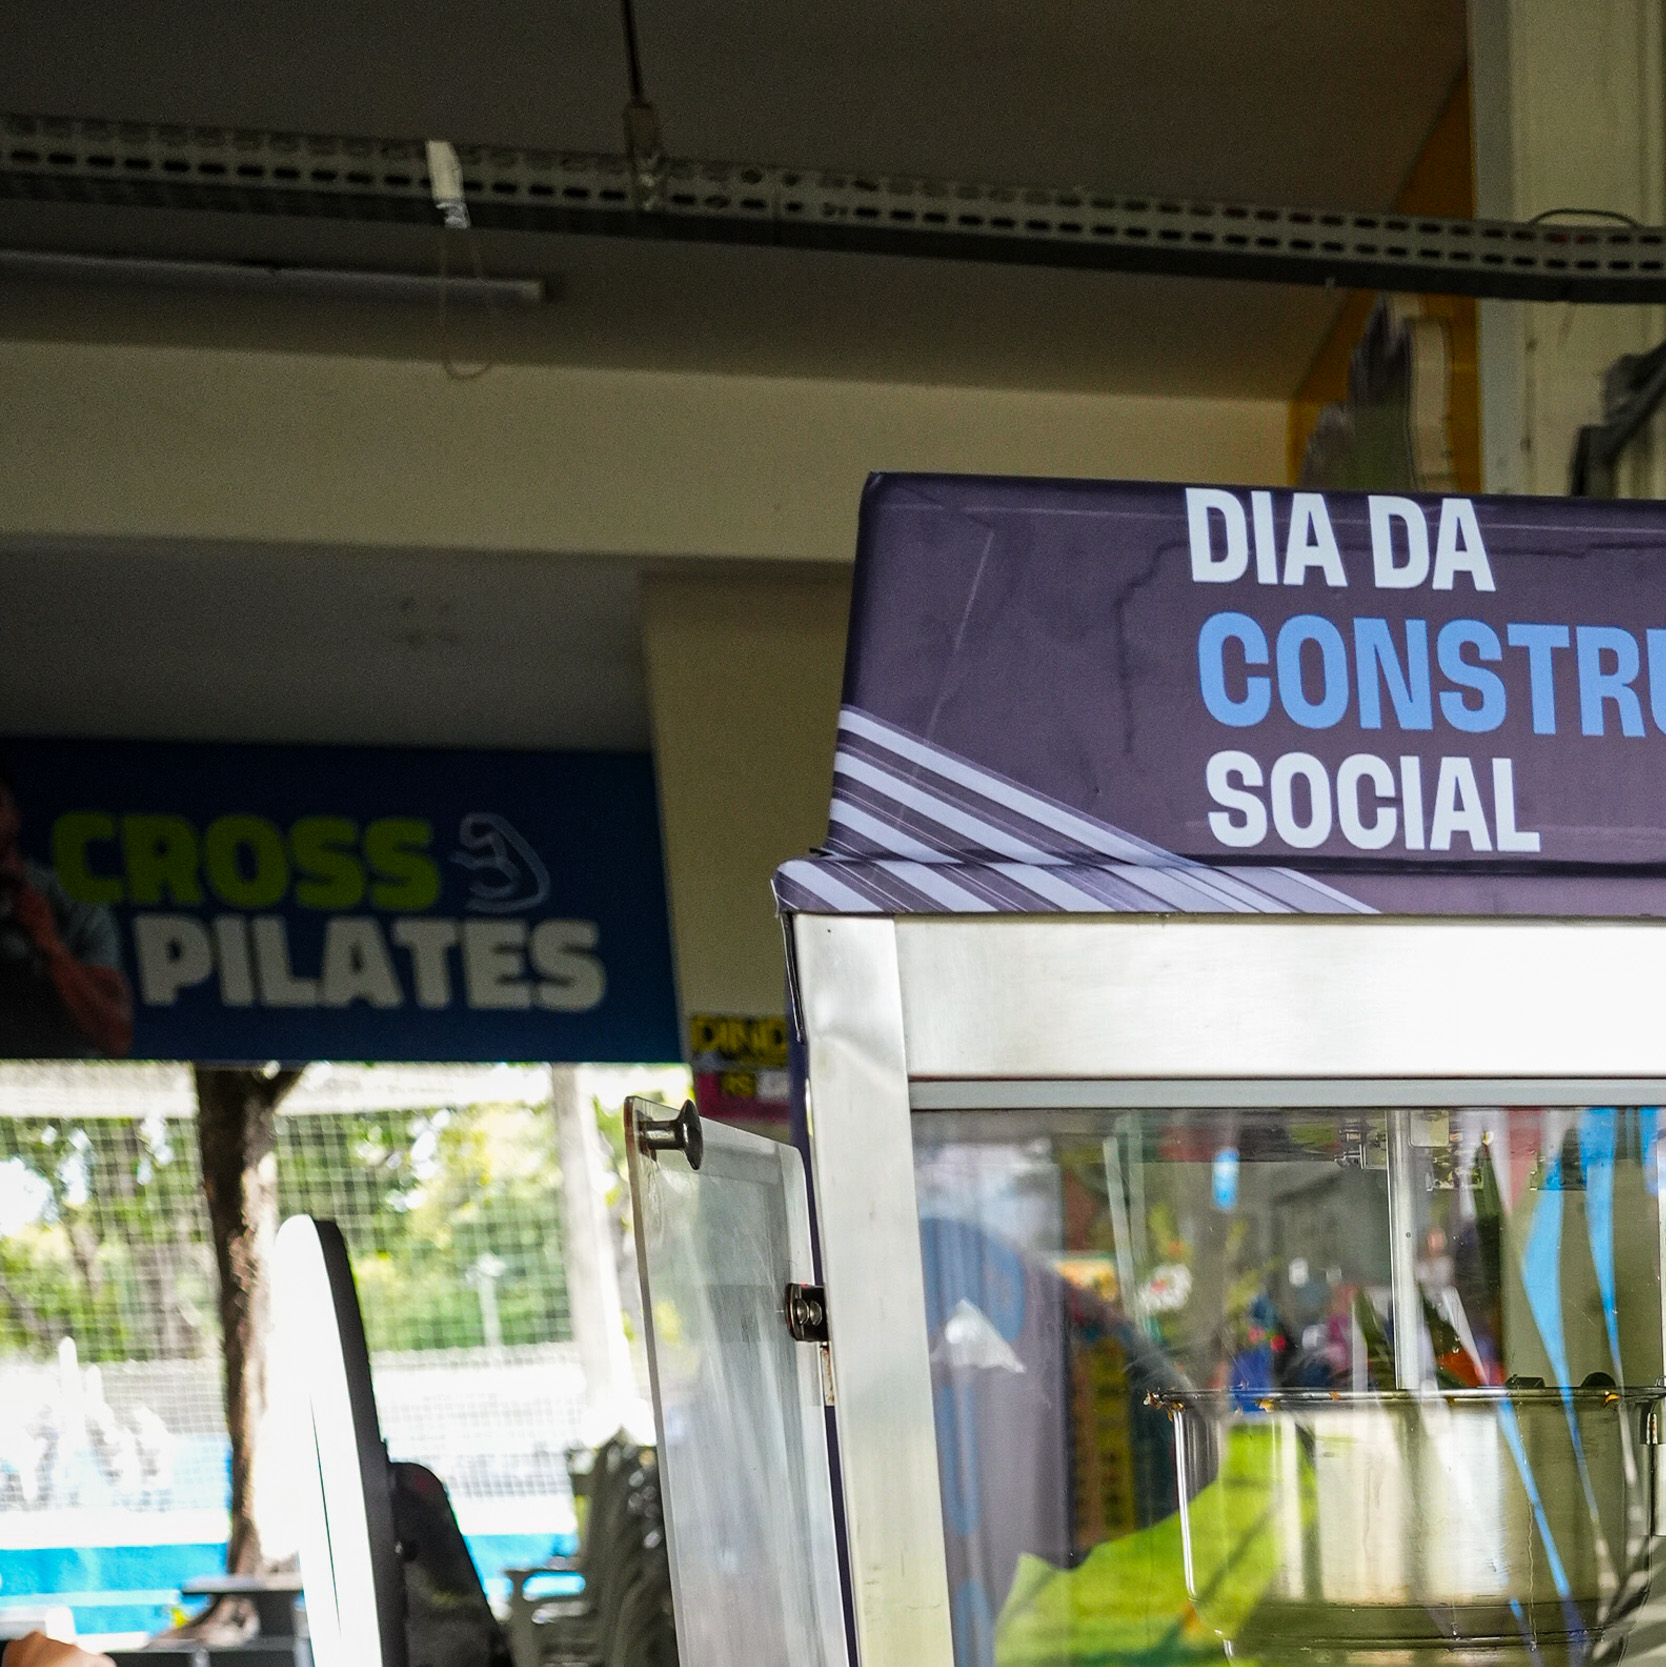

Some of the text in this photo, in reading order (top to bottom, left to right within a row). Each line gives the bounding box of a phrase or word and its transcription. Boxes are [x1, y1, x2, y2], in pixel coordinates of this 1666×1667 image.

[1186, 488, 1497, 592] DIA DA
[1207, 751, 1541, 853] SOCIAL
[51, 811, 441, 909] CROSS
[133, 913, 608, 1012] PILATES
